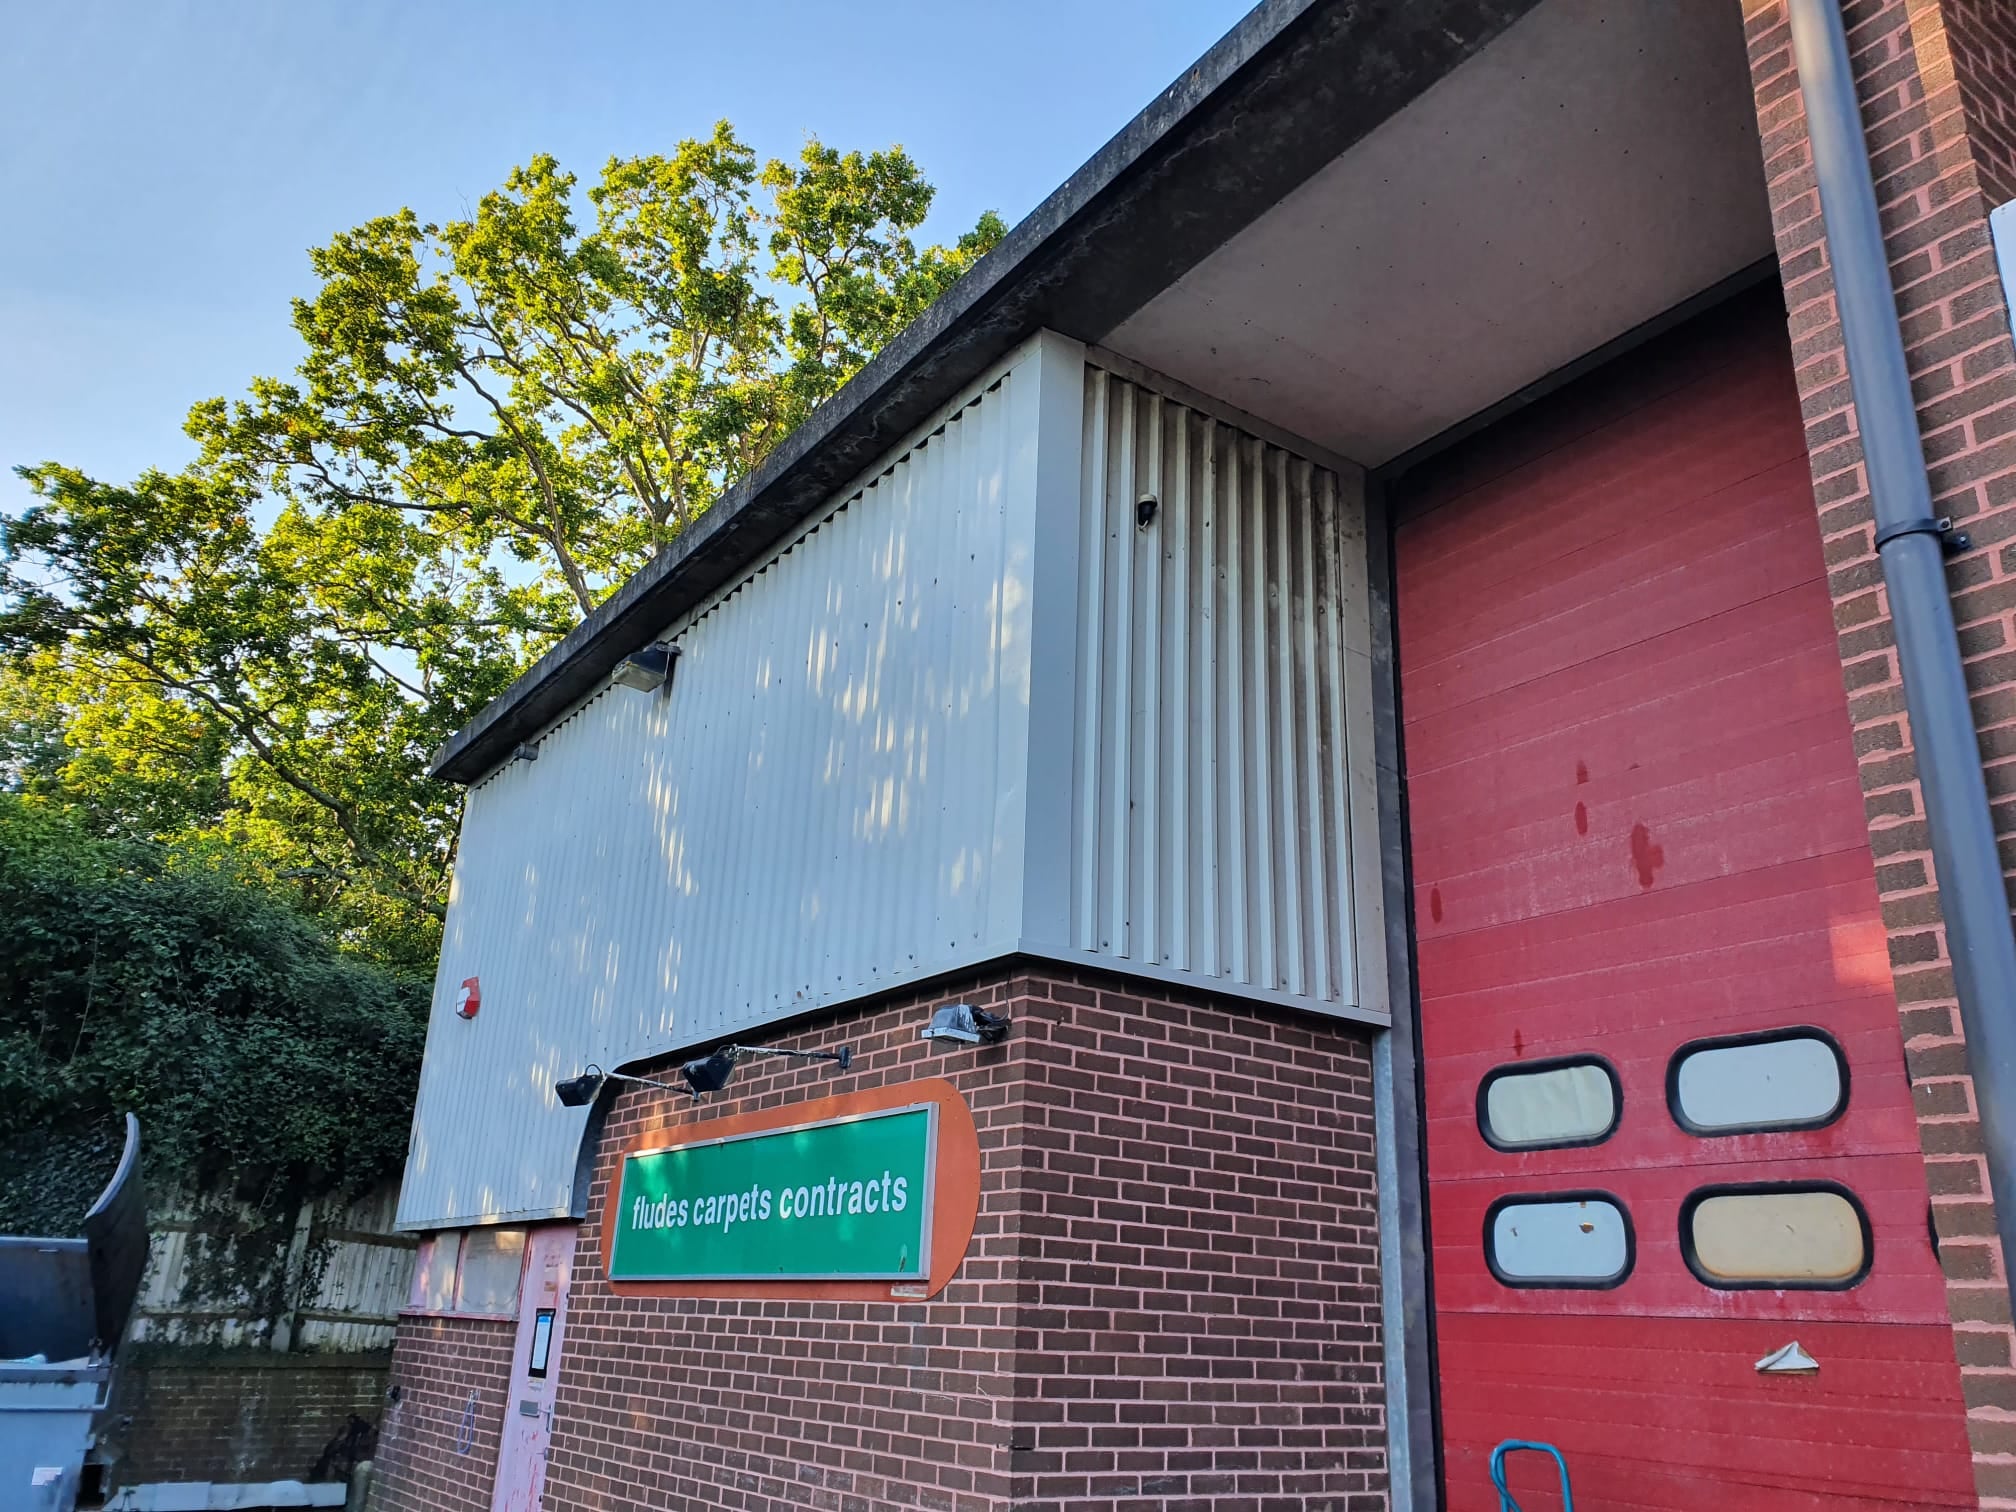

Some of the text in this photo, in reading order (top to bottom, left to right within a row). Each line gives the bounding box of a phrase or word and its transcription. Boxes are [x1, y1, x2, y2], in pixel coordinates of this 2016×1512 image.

[631, 1170, 907, 1234] fludes carpets contracts
